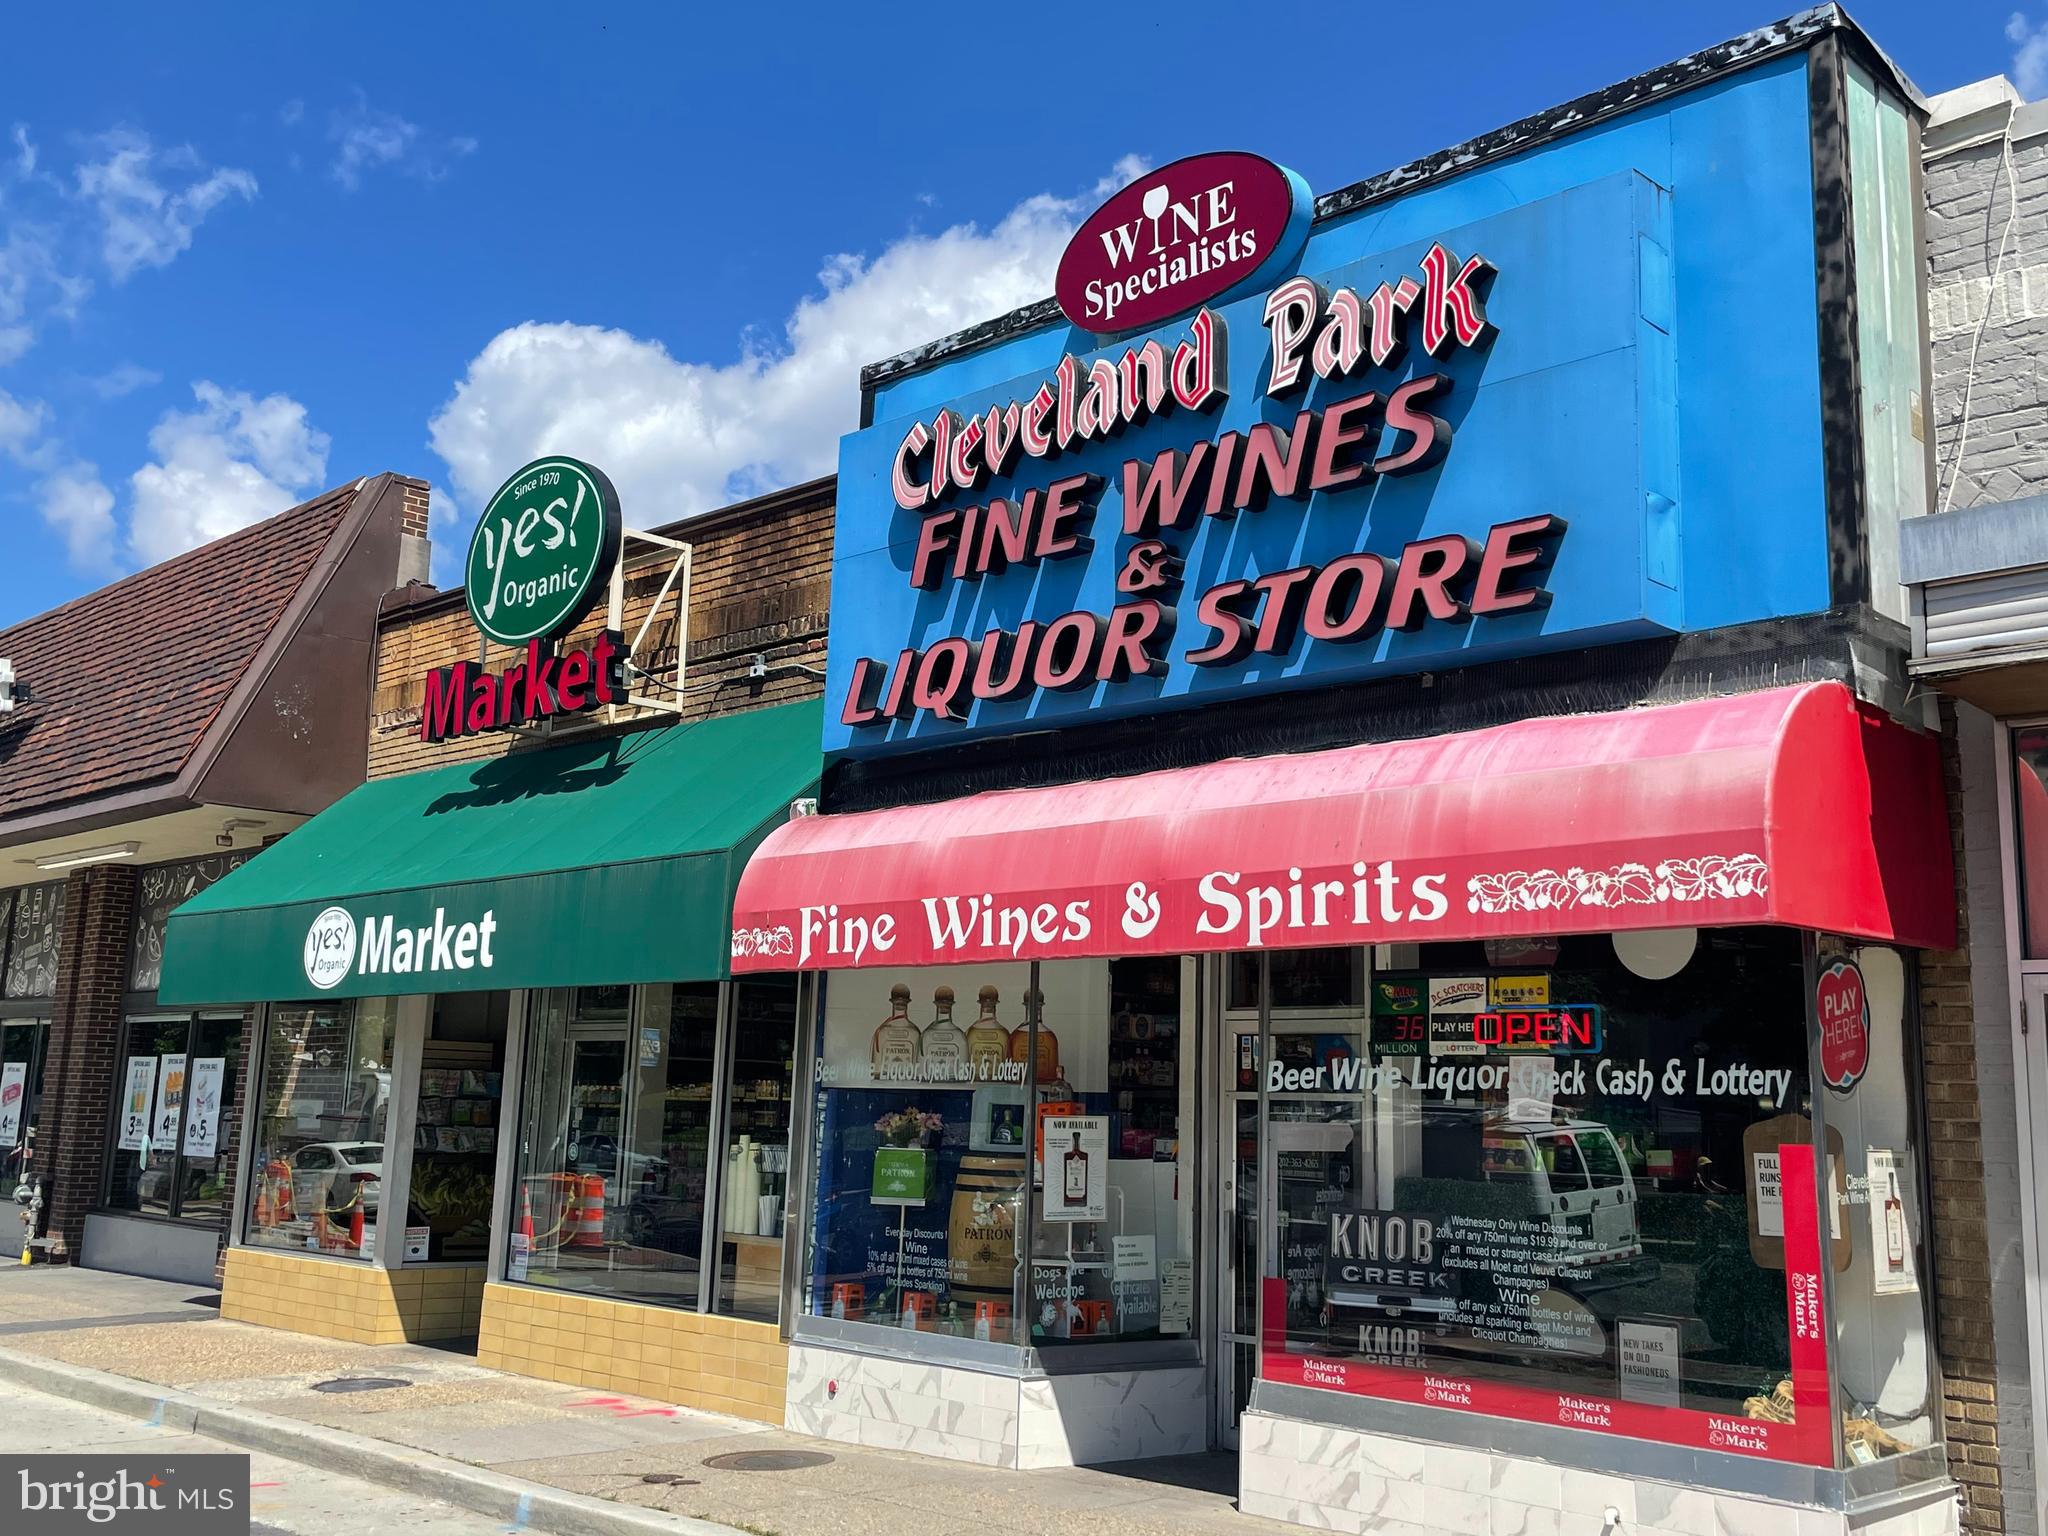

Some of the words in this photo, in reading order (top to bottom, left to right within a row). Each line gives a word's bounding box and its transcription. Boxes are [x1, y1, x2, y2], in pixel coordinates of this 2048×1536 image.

[1100, 181, 1236, 269] WINE
[1085, 227, 1257, 321] Specialists
[890, 307, 1226, 511] Cleveland
[1263, 242, 1496, 398] Park
[514, 478, 538, 500] Since
[539, 472, 560, 486] 1970
[910, 473, 1100, 589] FINE
[1123, 374, 1450, 535] WINES
[484, 480, 586, 620] yes!
[1117, 541, 1181, 594] &
[504, 564, 578, 608] Organic
[841, 601, 1172, 728] LIQUOR
[1186, 514, 1564, 667] STORE
[421, 631, 620, 742] Market
[799, 906, 897, 967] Fine
[922, 894, 1091, 962] Wines
[1122, 882, 1161, 938] &
[1196, 862, 1450, 946] Spirits
[312, 922, 349, 974] yes!
[358, 907, 497, 975] Market
[318, 954, 346, 973] Organic
[1443, 983, 1484, 997] SCRATCHERS
[1824, 987, 1857, 1019] PLAY
[1394, 1016, 1424, 1040] 36
[1432, 1022, 1456, 1032] PLAY
[1474, 1013, 1591, 1045] OPEN
[1825, 1014, 1861, 1048] HERE!
[1374, 1043, 1417, 1054] MILLION
[815, 1057, 839, 1082] Beer
[953, 1056, 975, 1084] Cash
[979, 1057, 989, 1081] &
[992, 1056, 1028, 1089] Lottery
[1267, 1060, 1326, 1092] Beer
[1332, 1057, 1401, 1095] Wine
[1519, 1059, 1586, 1100] Check
[1596, 1058, 1654, 1102] Cash
[1661, 1058, 1686, 1095] &
[1696, 1057, 1792, 1109] Lottery
[1053, 1121, 1067, 1129] NOW
[1068, 1121, 1098, 1129] AVAILABLE
[1758, 1158, 1779, 1170] FULL
[1760, 1172, 1781, 1184] RUNS
[1761, 1186, 1776, 1197] THE
[913, 1228, 944, 1240] Discounts
[1451, 1215, 1497, 1231] Wednesday
[1498, 1218, 1517, 1232] Only
[1519, 1220, 1540, 1232] Wine
[1542, 1222, 1583, 1236] Discounts
[905, 1241, 928, 1254] Wine
[1331, 1213, 1434, 1265] KNOB
[1436, 1227, 1454, 1239] 20%
[1455, 1228, 1466, 1240] off
[1467, 1231, 1482, 1243] any
[1483, 1231, 1508, 1243] 750ml
[1509, 1234, 1528, 1245] wine
[1530, 1234, 1559, 1248] $19.99
[1560, 1237, 1575, 1249] and
[1579, 1240, 1596, 1250] over
[1599, 1242, 1608, 1251] or
[868, 1250, 879, 1262] 10%
[880, 1251, 888, 1262] off
[896, 1252, 912, 1264] 70ml
[913, 1255, 930, 1267] mixed
[930, 1258, 947, 1268] cases
[954, 1260, 968, 1269] wine
[1466, 1243, 1489, 1256] mixed
[1491, 1247, 1500, 1257] or
[1501, 1247, 1532, 1263] straight
[1532, 1251, 1551, 1262] case
[1553, 1251, 1563, 1262] of
[1564, 1254, 1584, 1265] wine
[867, 1262, 877, 1272] 5%
[877, 1263, 885, 1273] off
[886, 1265, 896, 1276] any
[907, 1266, 927, 1277] bottles
[928, 1268, 934, 1278] of
[934, 1268, 953, 1279] 750ml
[954, 1271, 968, 1281] wine
[1034, 1267, 1061, 1281] Dogs
[1341, 1265, 1449, 1289] CREEK
[1441, 1256, 1478, 1270] (excludes
[1479, 1258, 1489, 1271] all
[1490, 1260, 1511, 1272] Moet
[1513, 1261, 1528, 1273] and
[1529, 1264, 1555, 1276] Veuve
[1557, 1265, 1592, 1281] Clicquot
[914, 1279, 946, 1293] Sparkling)
[1035, 1284, 1085, 1300] Welcome
[1493, 1273, 1550, 1291] Champagnes)
[1116, 1296, 1157, 1315] Available
[1498, 1287, 1541, 1306] Wine
[1806, 1273, 1819, 1339] Maker's
[1459, 1299, 1470, 1310] off
[1472, 1303, 1487, 1314] any
[1489, 1303, 1501, 1314] six
[1503, 1303, 1530, 1316] 750ml
[1532, 1307, 1561, 1320] bottles
[1563, 1308, 1572, 1321] of
[1574, 1312, 1595, 1323] wine
[1794, 1291, 1807, 1338] Mark
[1475, 1313, 1485, 1325] all
[1486, 1315, 1522, 1332] sparkling
[1523, 1321, 1551, 1335] except
[1552, 1322, 1574, 1336] Moet
[1575, 1325, 1591, 1337] and
[1359, 1324, 1420, 1357] KNOB
[1471, 1326, 1507, 1343] Clicquot
[1508, 1330, 1568, 1350] Champagnes)
[1623, 1339, 1639, 1349] NEW
[1642, 1340, 1664, 1352] TAKES
[1303, 1359, 1346, 1374] Maker's
[1365, 1354, 1428, 1369] CREEK
[1624, 1351, 1634, 1361] ON
[1636, 1353, 1650, 1363] OLD
[1315, 1373, 1346, 1386] Mark
[1624, 1364, 1670, 1379] FASHIONEDS
[1424, 1376, 1471, 1392] Maker's
[1437, 1390, 1471, 1405] Mark
[1558, 1396, 1611, 1414] Maker's
[1573, 1411, 1611, 1427] Mark
[1708, 1418, 1767, 1437] Maker's
[1725, 1434, 1768, 1450] Mark
